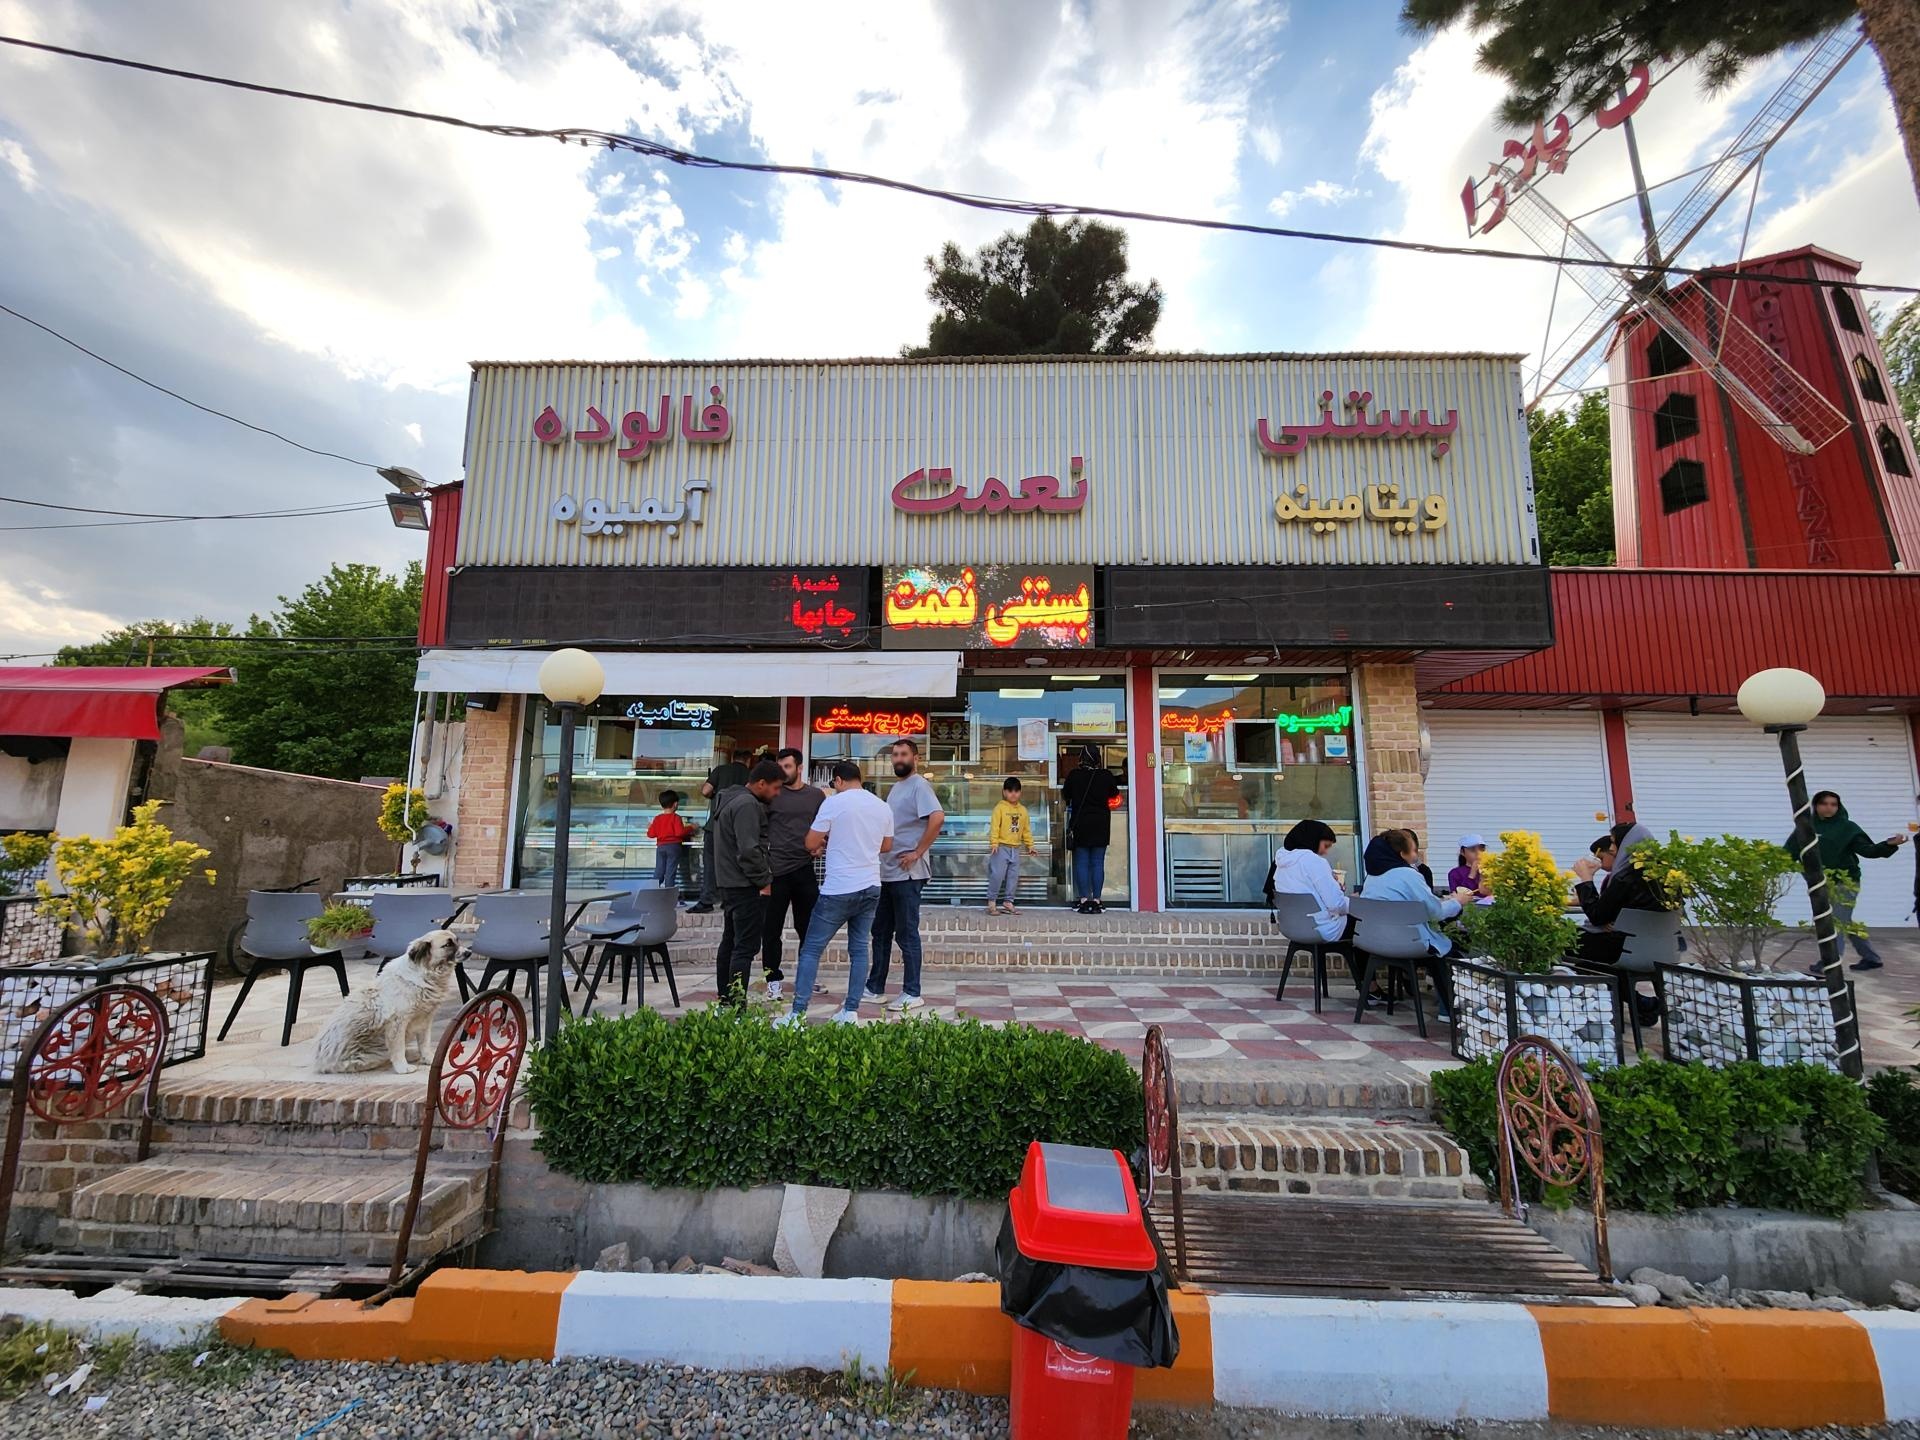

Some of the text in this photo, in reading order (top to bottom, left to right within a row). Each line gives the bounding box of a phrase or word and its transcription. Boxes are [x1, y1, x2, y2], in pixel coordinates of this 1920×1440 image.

[534, 385, 731, 462] فالوده
[1257, 390, 1459, 459] بستنی
[553, 480, 710, 537] آبمیوه
[892, 457, 1089, 515] نعمت
[1275, 484, 1449, 535] ویتامینه
[885, 567, 1091, 647] بستنی نعمت
[626, 699, 714, 728] ویتامینه
[816, 707, 925, 736] هویج بستنی
[1277, 705, 1352, 734] آبمیوه
